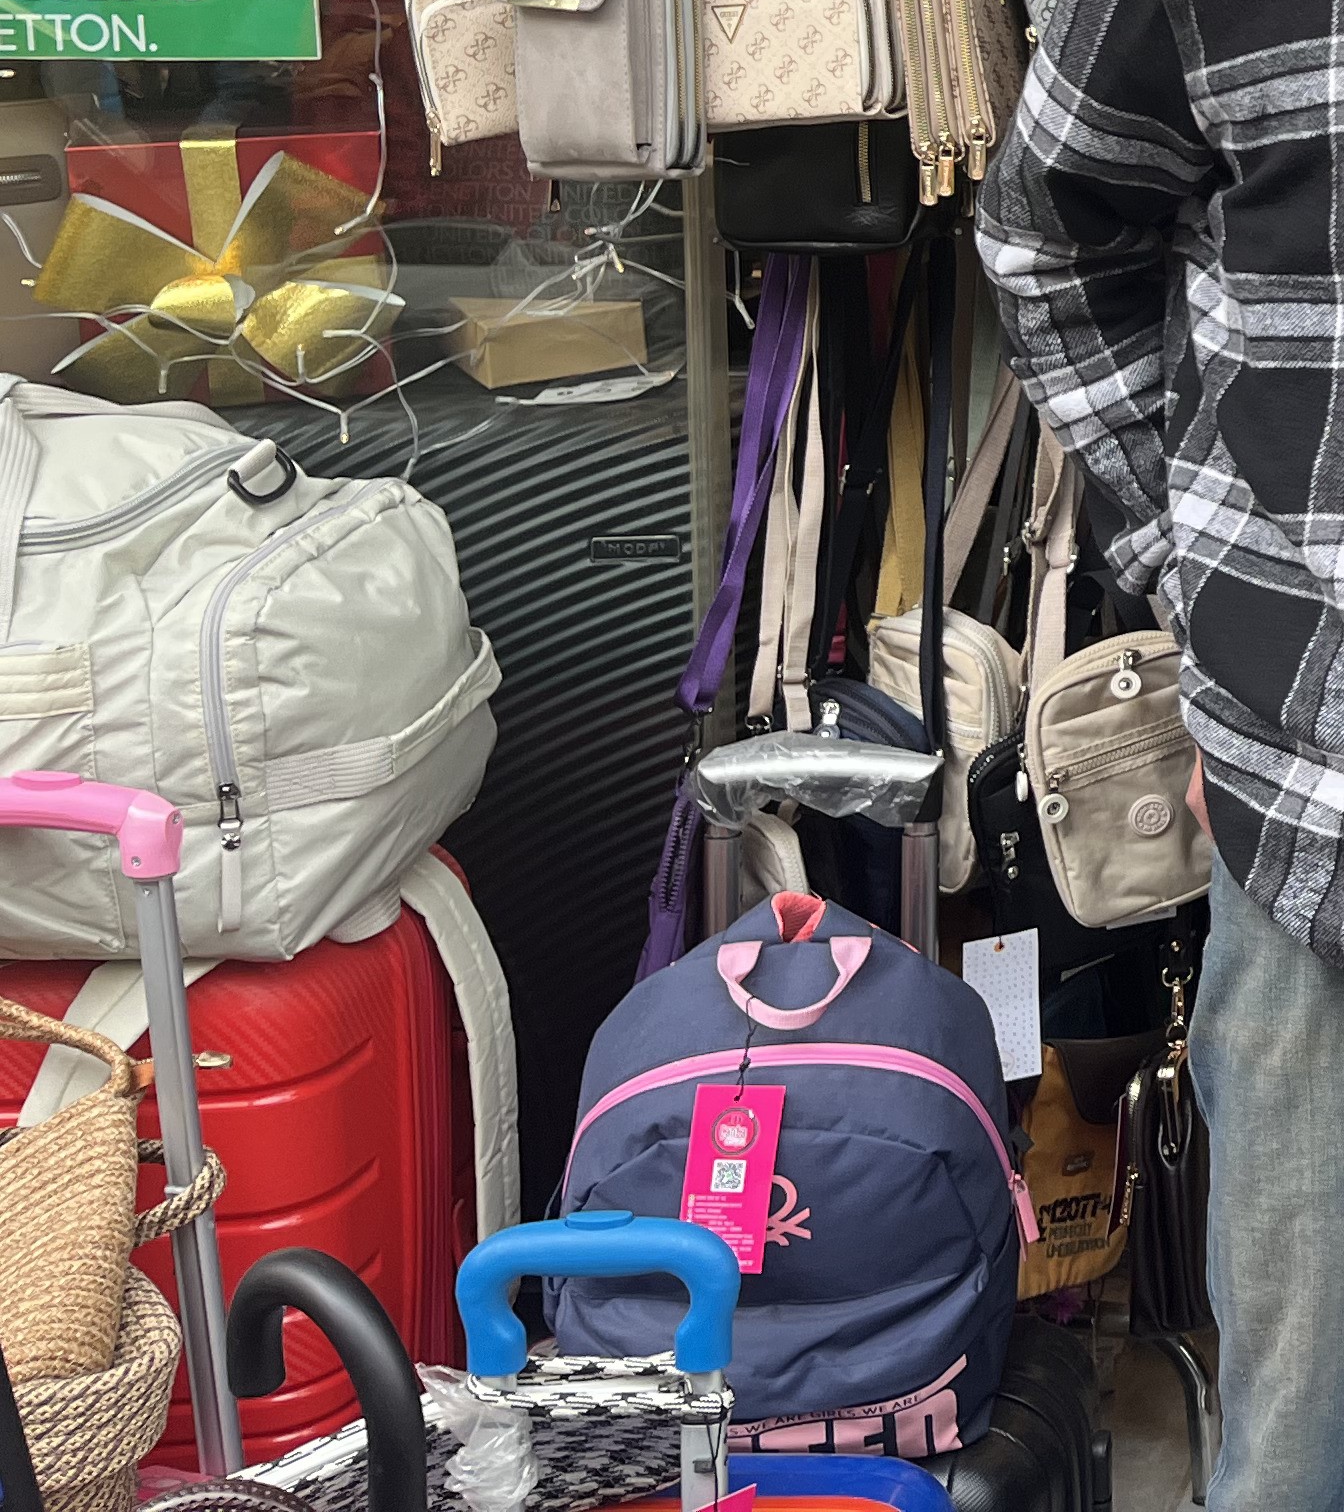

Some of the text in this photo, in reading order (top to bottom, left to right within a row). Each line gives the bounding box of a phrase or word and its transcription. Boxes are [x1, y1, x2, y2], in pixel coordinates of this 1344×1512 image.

[744, 1421, 770, 1434] WE
[775, 1413, 802, 1426] ARE
[809, 1409, 856, 1420] GIRLS
[862, 1405, 888, 1416] WE
[892, 1395, 920, 1411] ARE
